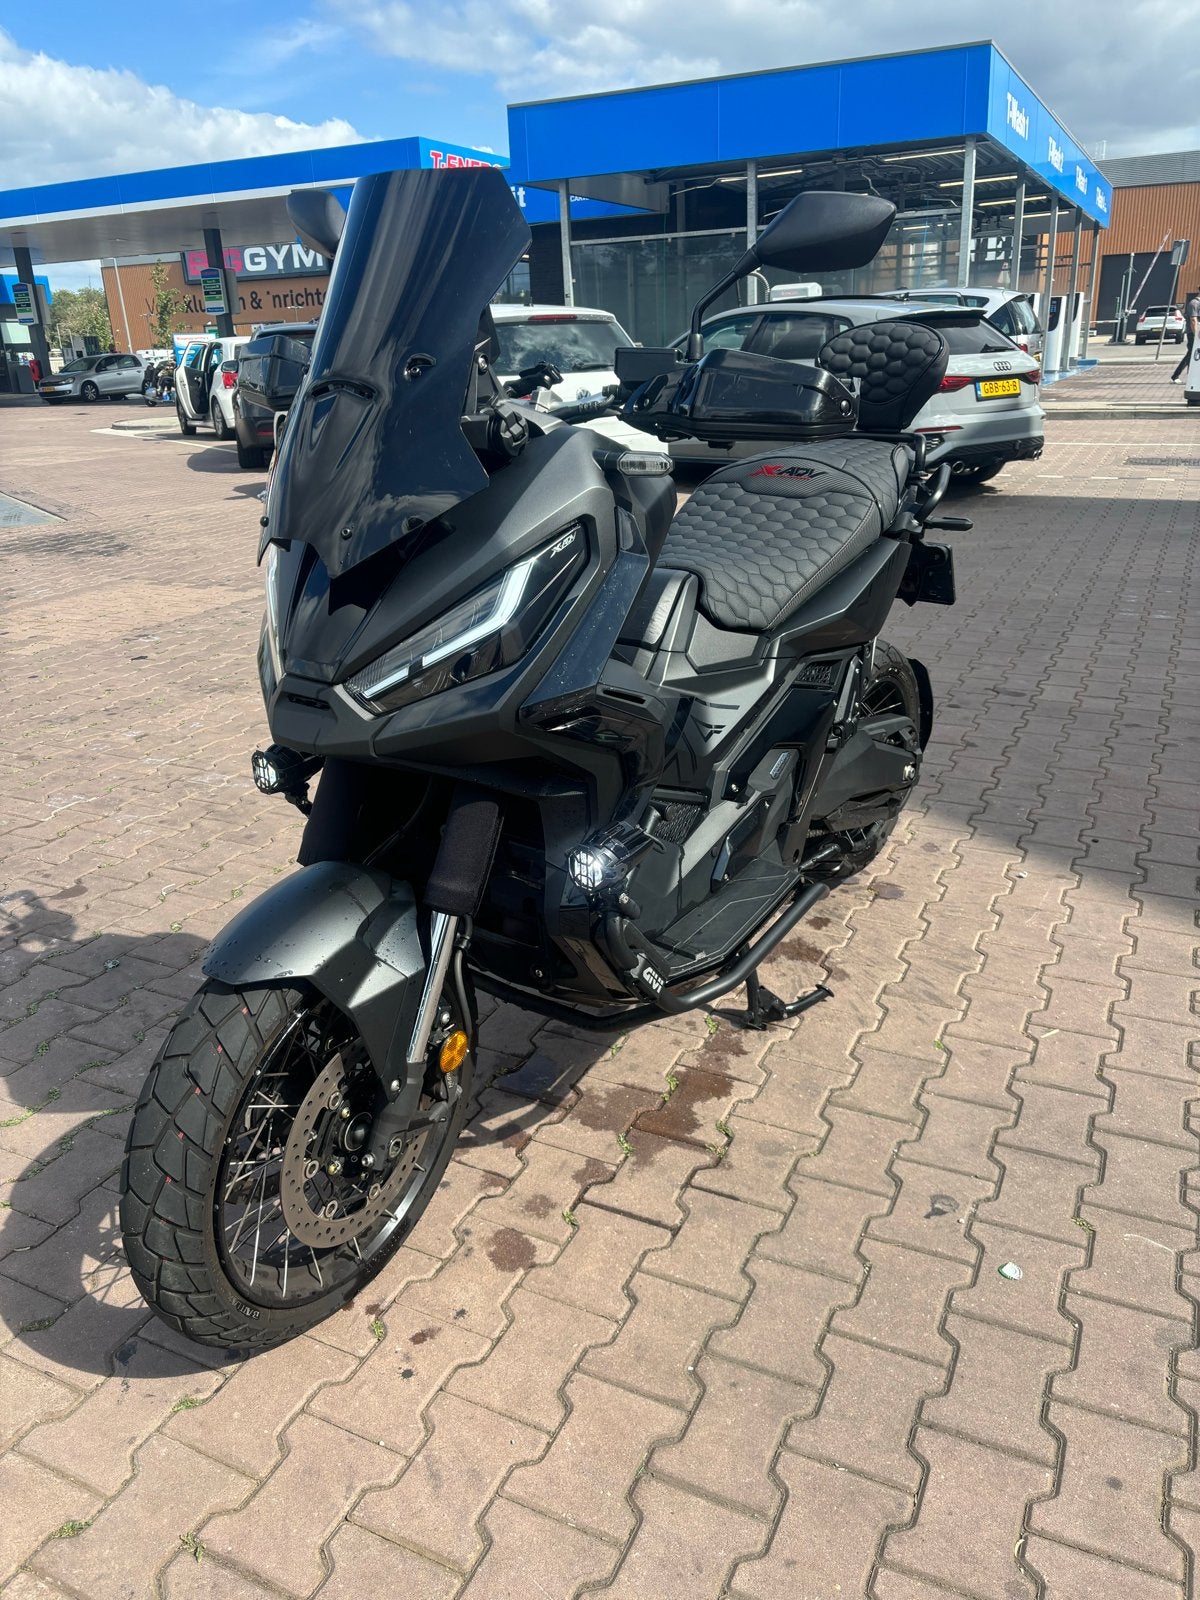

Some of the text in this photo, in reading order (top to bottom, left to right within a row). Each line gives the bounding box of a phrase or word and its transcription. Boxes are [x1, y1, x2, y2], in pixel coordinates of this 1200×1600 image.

[250, 291, 263, 310] &
[983, 380, 1018, 394] GBB-63-B
[748, 465, 828, 481] X-ADV
[642, 966, 665, 994] GIVI
